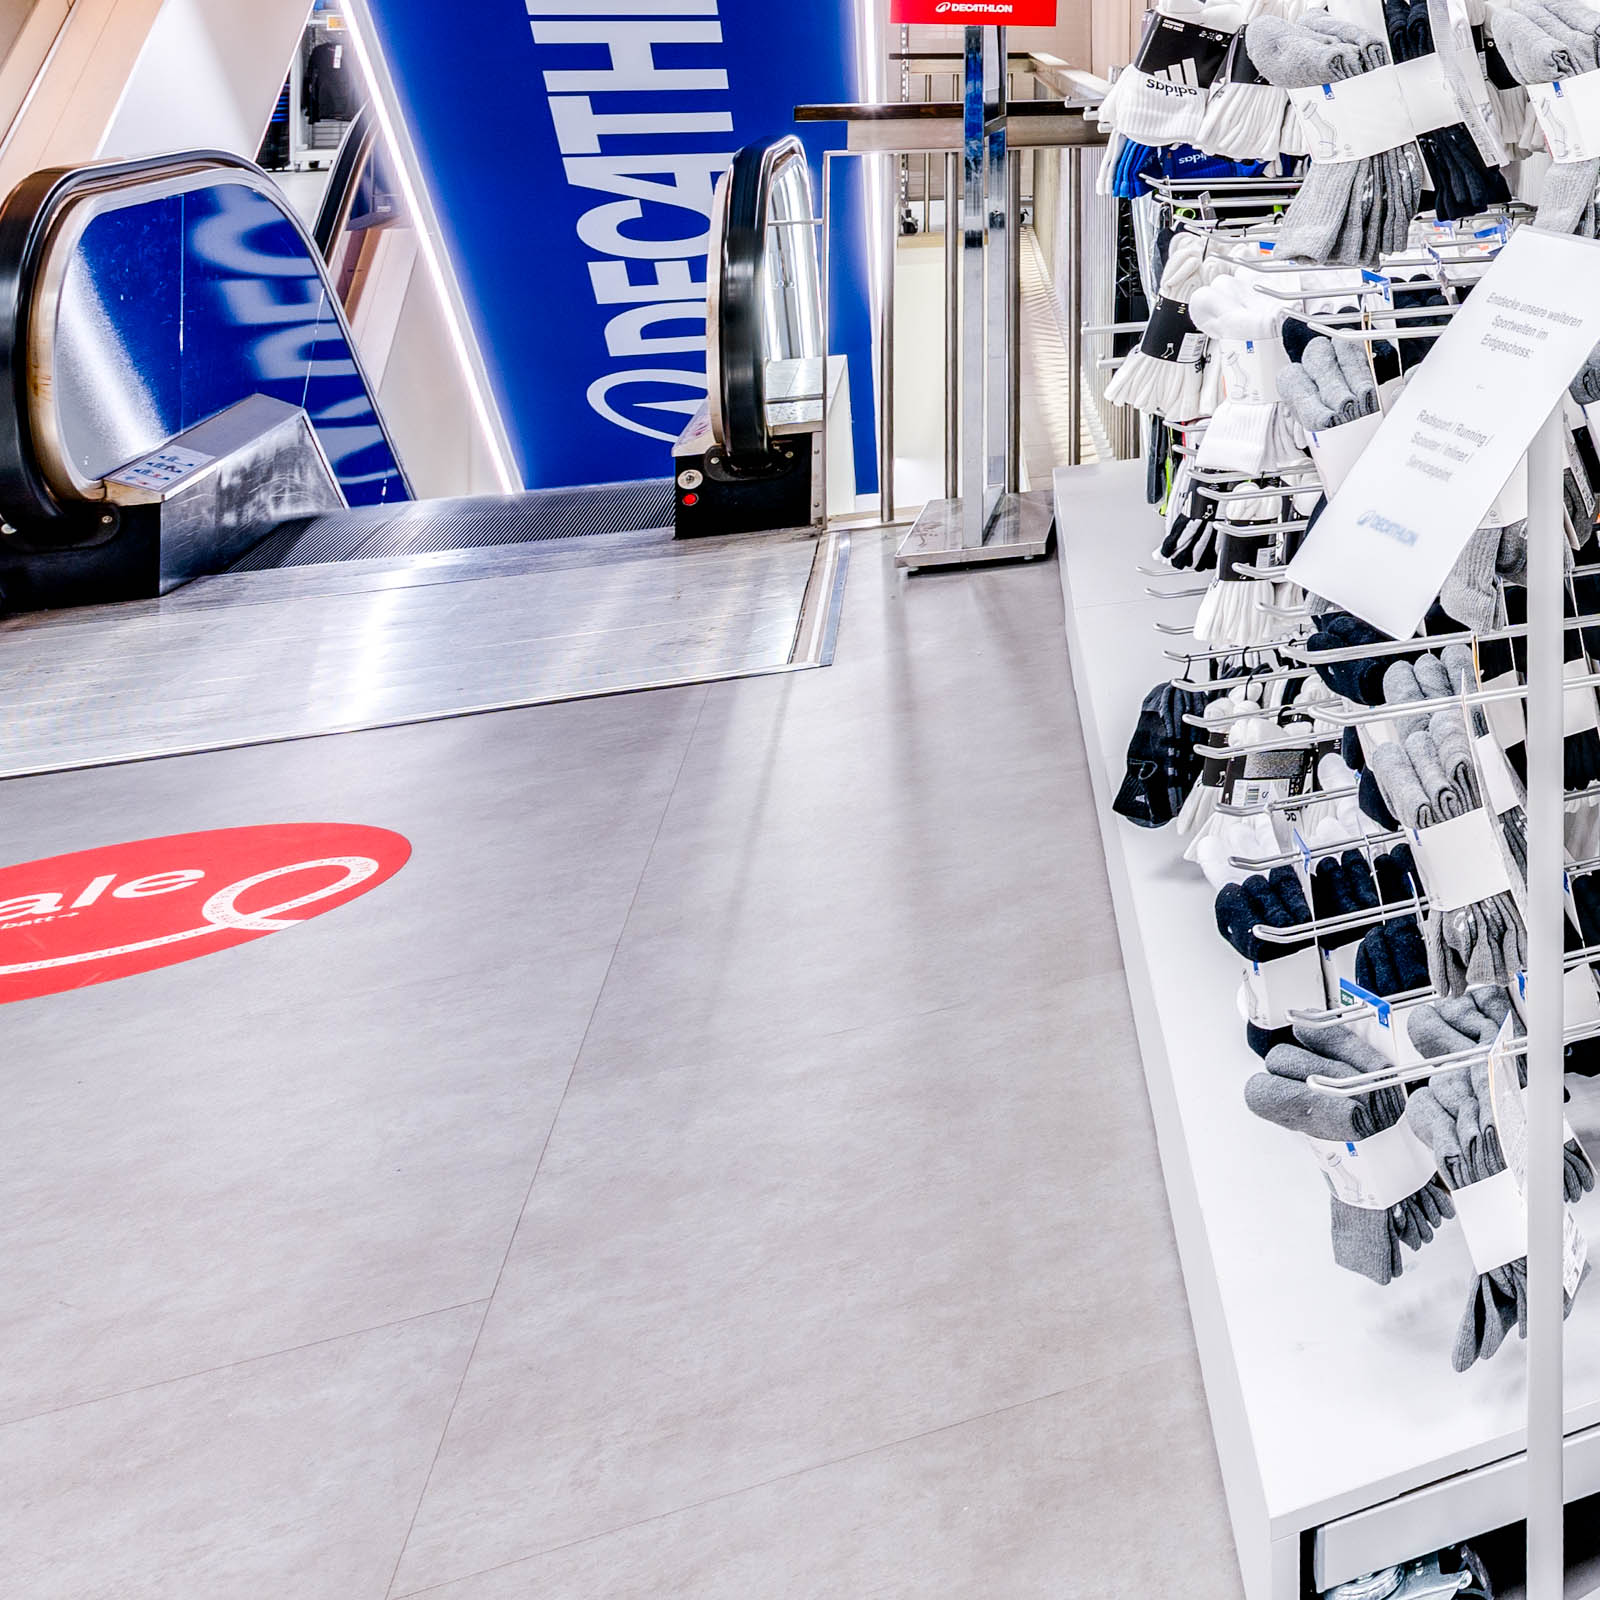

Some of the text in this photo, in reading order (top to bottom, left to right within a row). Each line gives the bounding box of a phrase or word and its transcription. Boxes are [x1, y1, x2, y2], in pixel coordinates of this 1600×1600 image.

[951, 2, 1013, 13] DECATHLON
[1146, 78, 1198, 97] adidas
[1519, 299, 1554, 319] unsere
[1547, 308, 1583, 329] weiteren
[0, 868, 206, 921] ale
